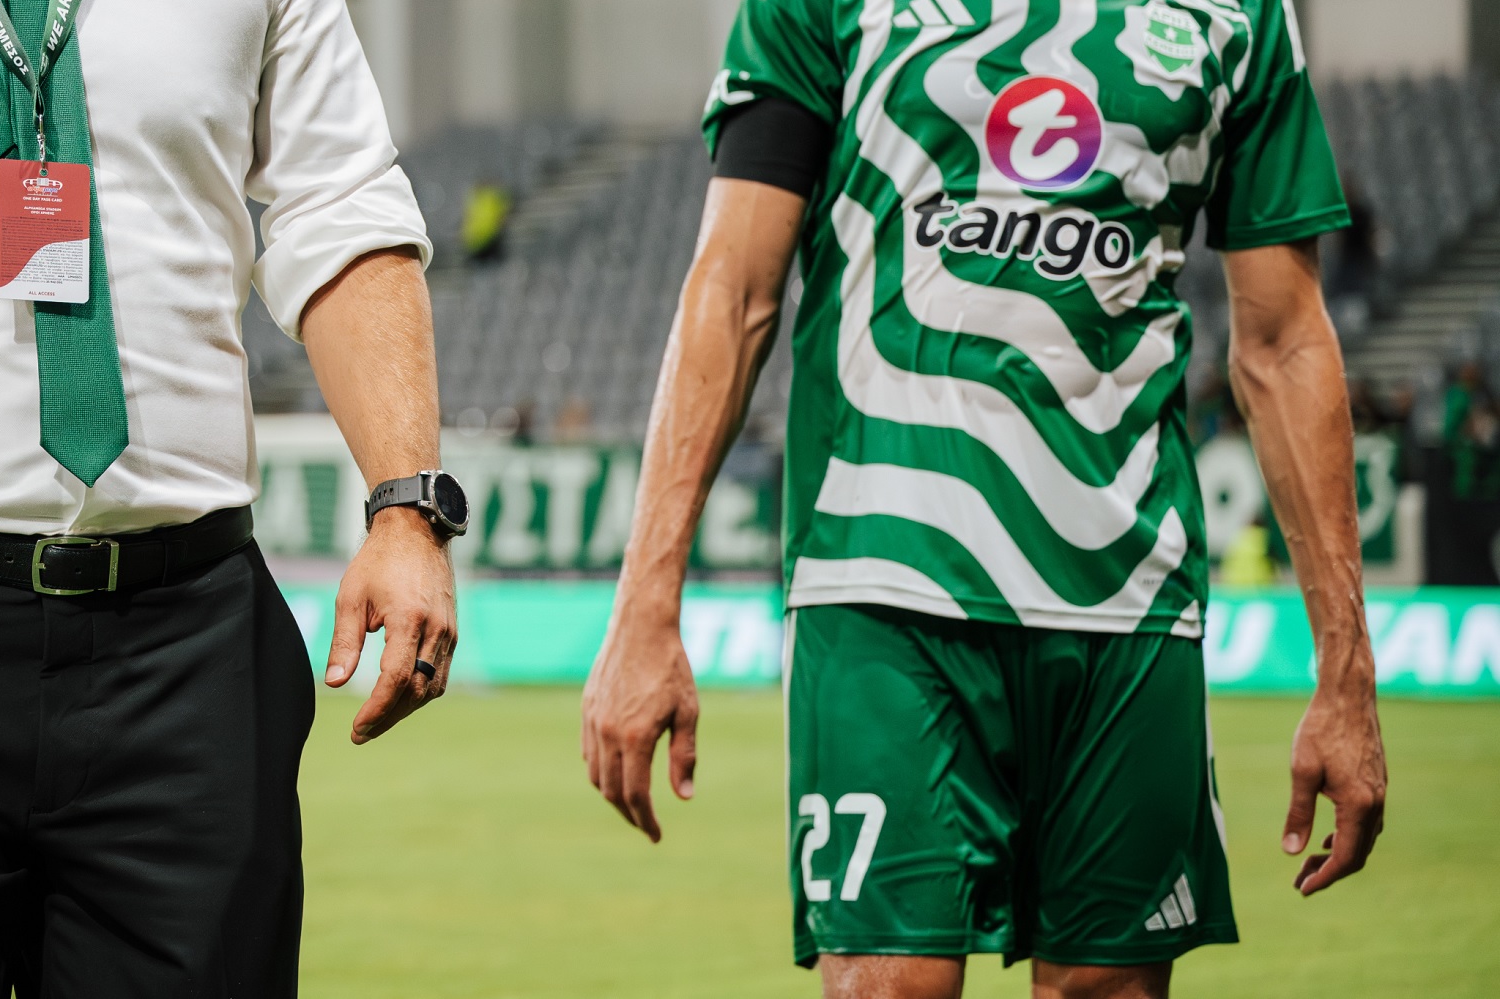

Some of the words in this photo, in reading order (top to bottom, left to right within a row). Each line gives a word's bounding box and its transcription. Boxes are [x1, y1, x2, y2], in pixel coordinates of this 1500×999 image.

[46, 19, 64, 51] WE
[912, 191, 1133, 278] tango
[797, 791, 888, 903] 27
